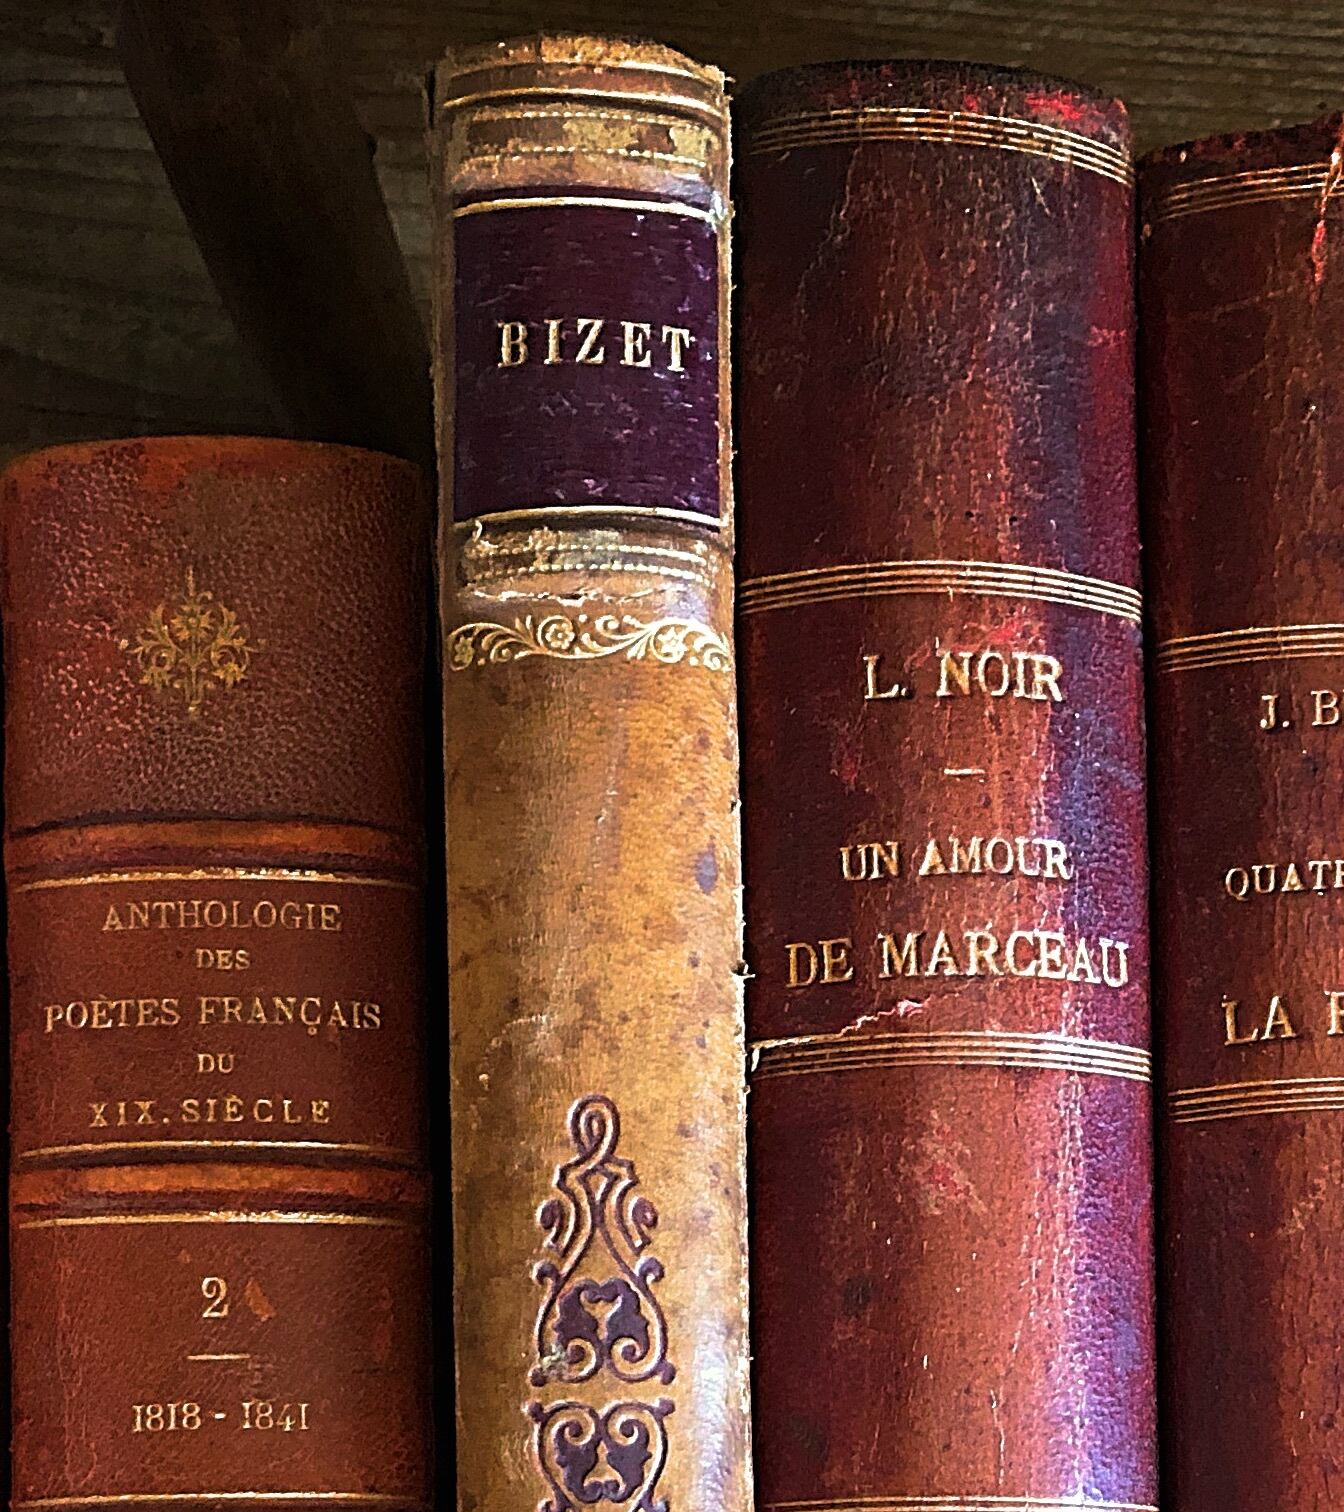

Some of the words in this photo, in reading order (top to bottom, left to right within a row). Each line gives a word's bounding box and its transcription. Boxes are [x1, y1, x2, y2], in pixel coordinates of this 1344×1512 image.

[495, 318, 691, 373] BIZET
[863, 653, 909, 701] L.
[935, 650, 1064, 702] NOIR
[1258, 694, 1290, 729] J.
[839, 841, 902, 881] UN
[918, 836, 1073, 881] AMOUR
[102, 901, 343, 932] ANTHOLOGIE
[196, 949, 250, 971] DES
[785, 937, 854, 990] DE
[877, 929, 1130, 989] MARCEAU
[198, 996, 382, 1036] FRANÇAIS
[1221, 995, 1298, 1046] LA
[197, 1053, 235, 1074] DU
[181, 1094, 331, 1125] SIÈCLE
[202, 1277, 230, 1319] 2
